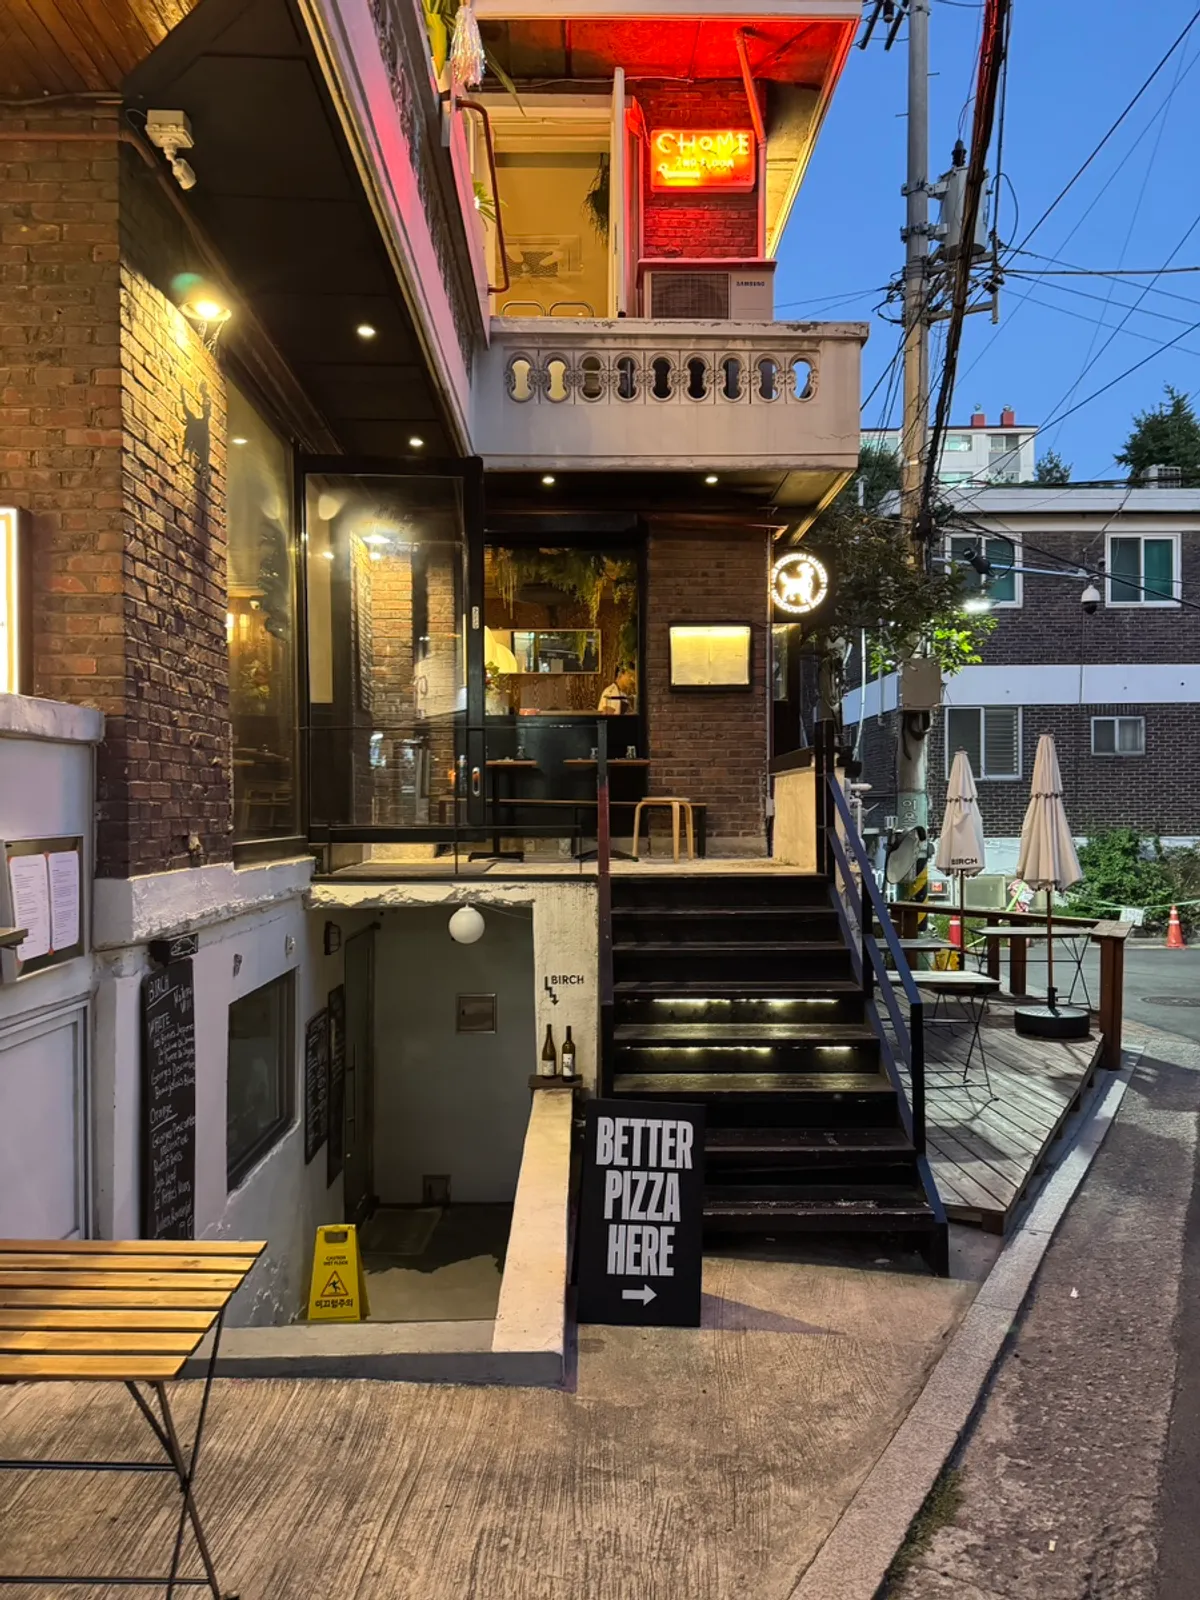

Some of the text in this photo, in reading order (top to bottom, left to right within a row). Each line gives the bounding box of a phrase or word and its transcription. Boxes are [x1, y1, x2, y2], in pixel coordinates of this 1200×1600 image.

[656, 131, 749, 155] CHOME
[551, 975, 584, 985] BIRCH
[596, 1117, 694, 1169] BETTER
[604, 1170, 681, 1222] PIZZA
[607, 1224, 675, 1276] HERE
[315, 1298, 353, 1309] 미끄럼주의
